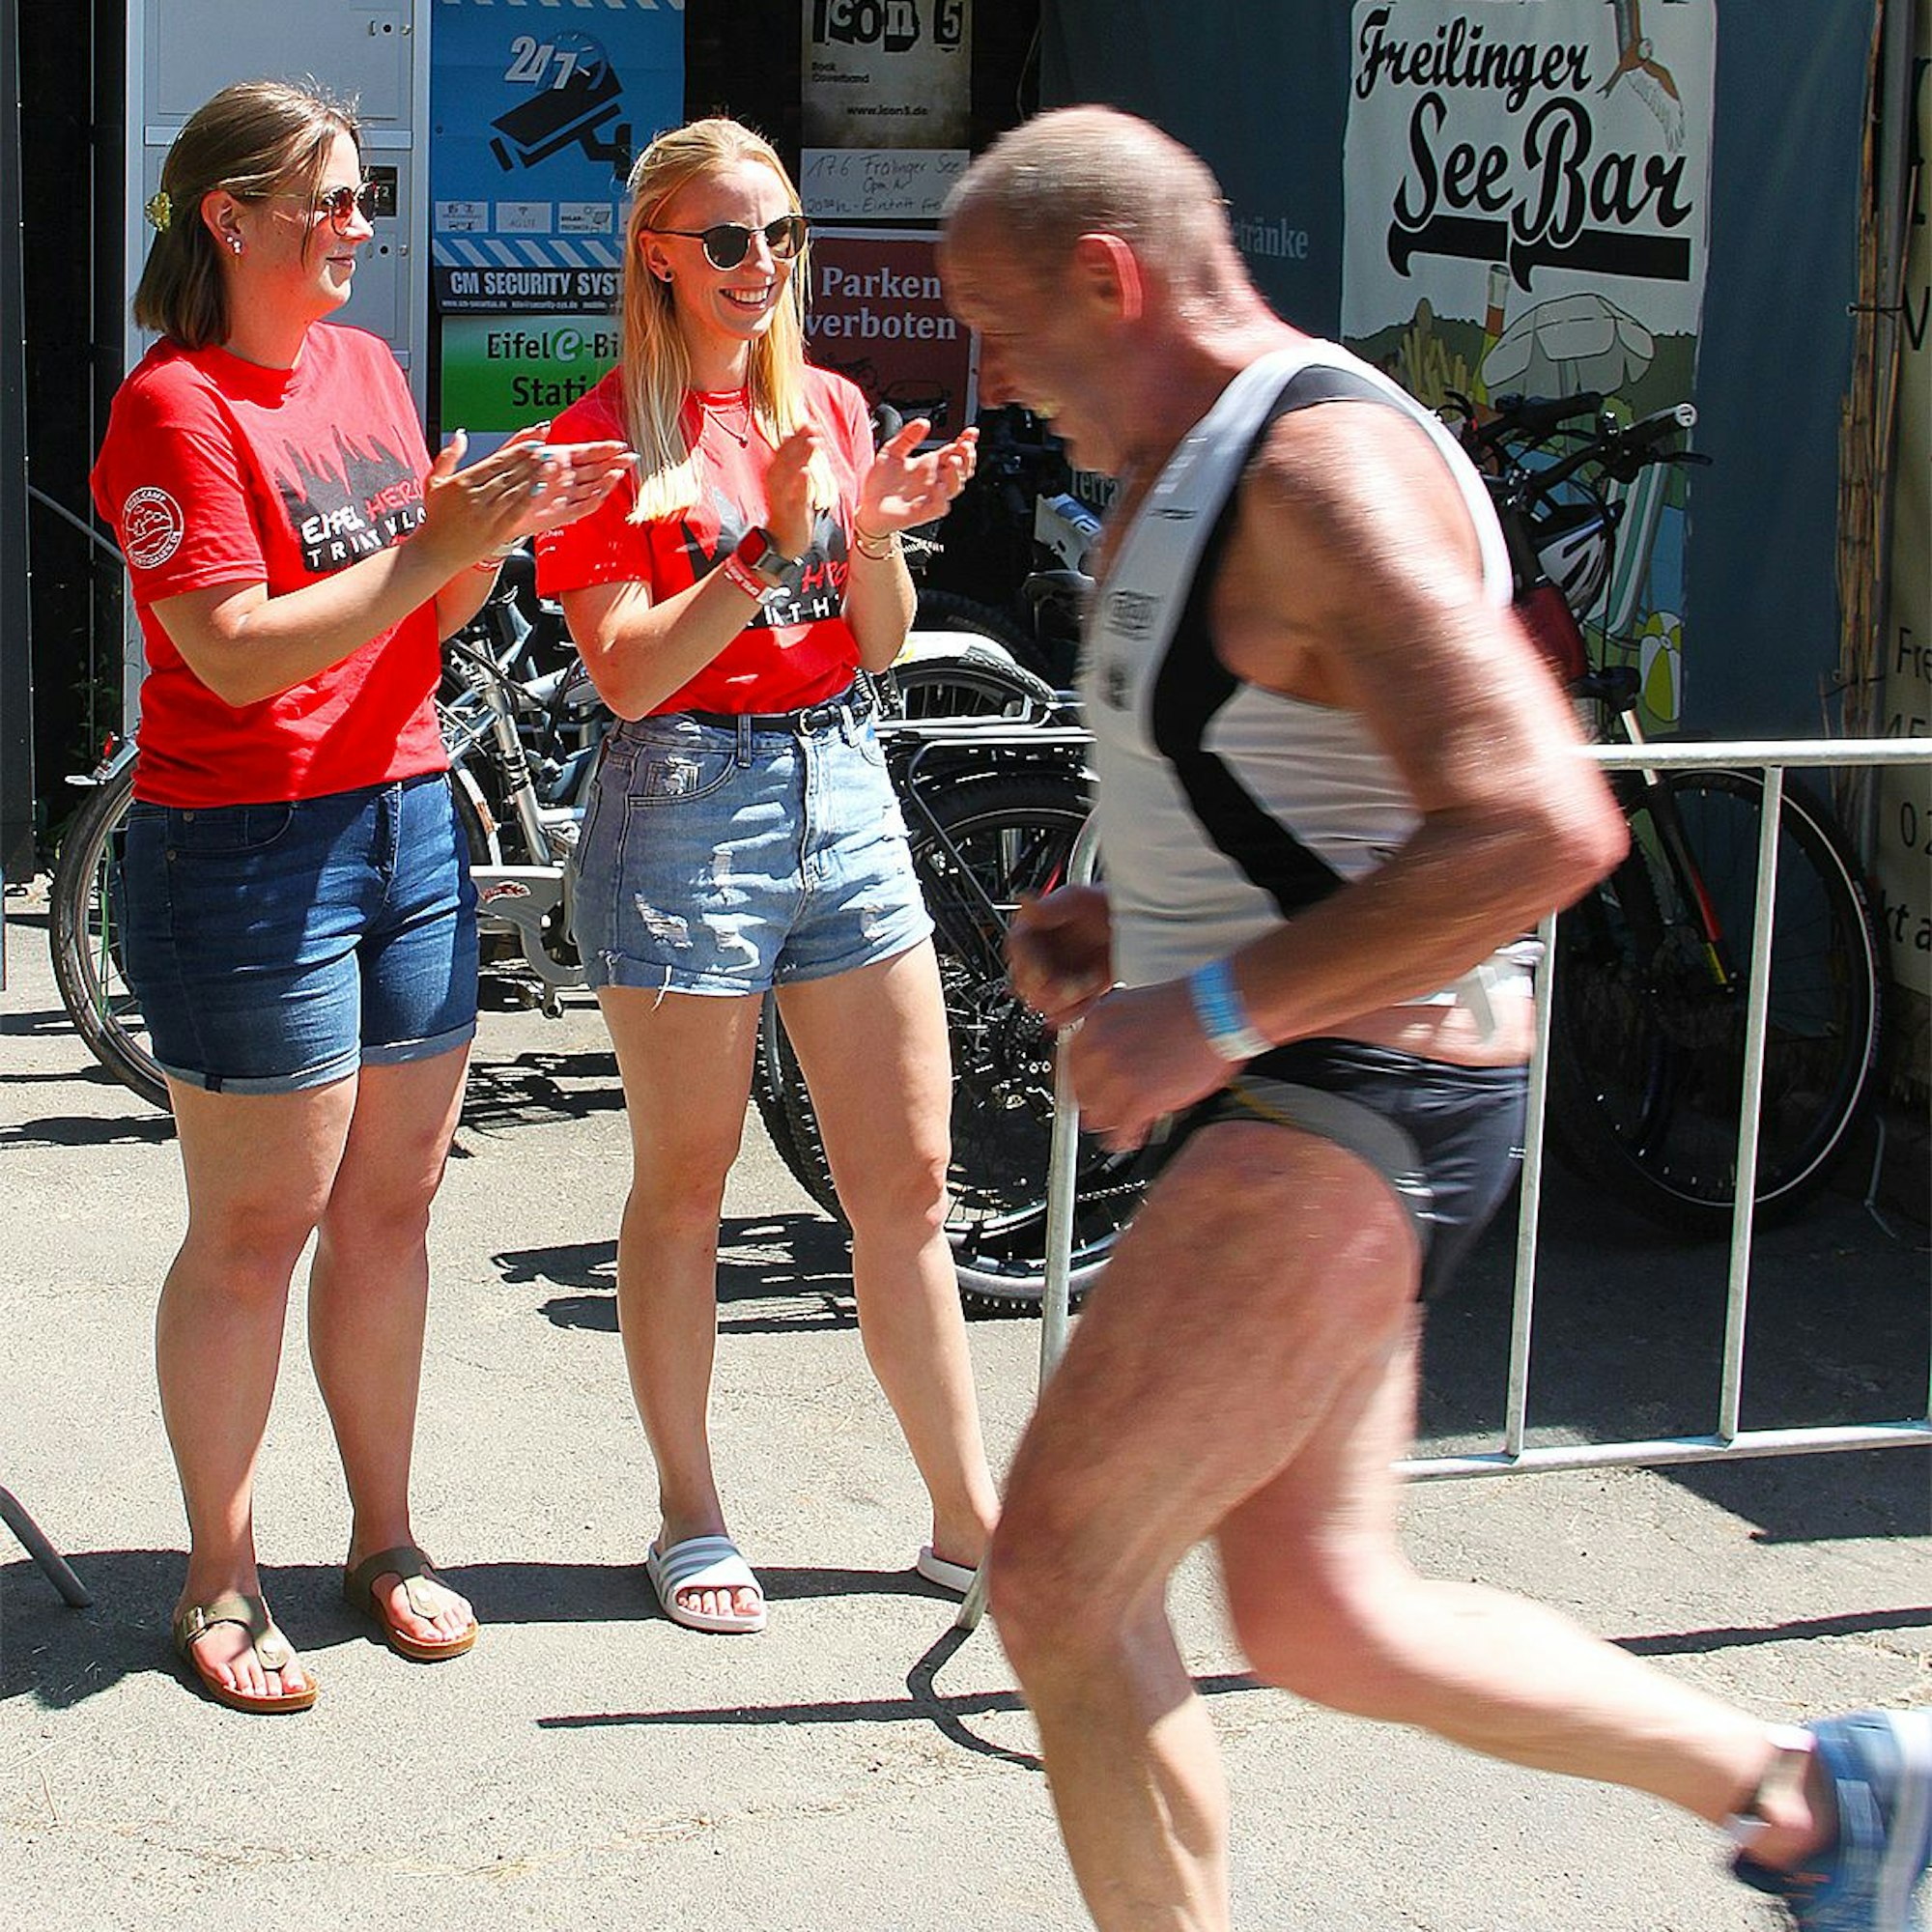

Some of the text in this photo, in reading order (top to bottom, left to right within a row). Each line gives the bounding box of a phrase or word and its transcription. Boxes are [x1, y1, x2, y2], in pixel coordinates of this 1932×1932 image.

[1354, 6, 1592, 112] Freilinger
[1232, 216, 1309, 260] tränke
[450, 271, 625, 297] CM SECURITY SYST
[822, 266, 942, 300] Parken
[805, 306, 957, 341] verboten
[487, 331, 551, 359] Eifel
[512, 376, 590, 408] Stati
[300, 504, 366, 545] EIFEL
